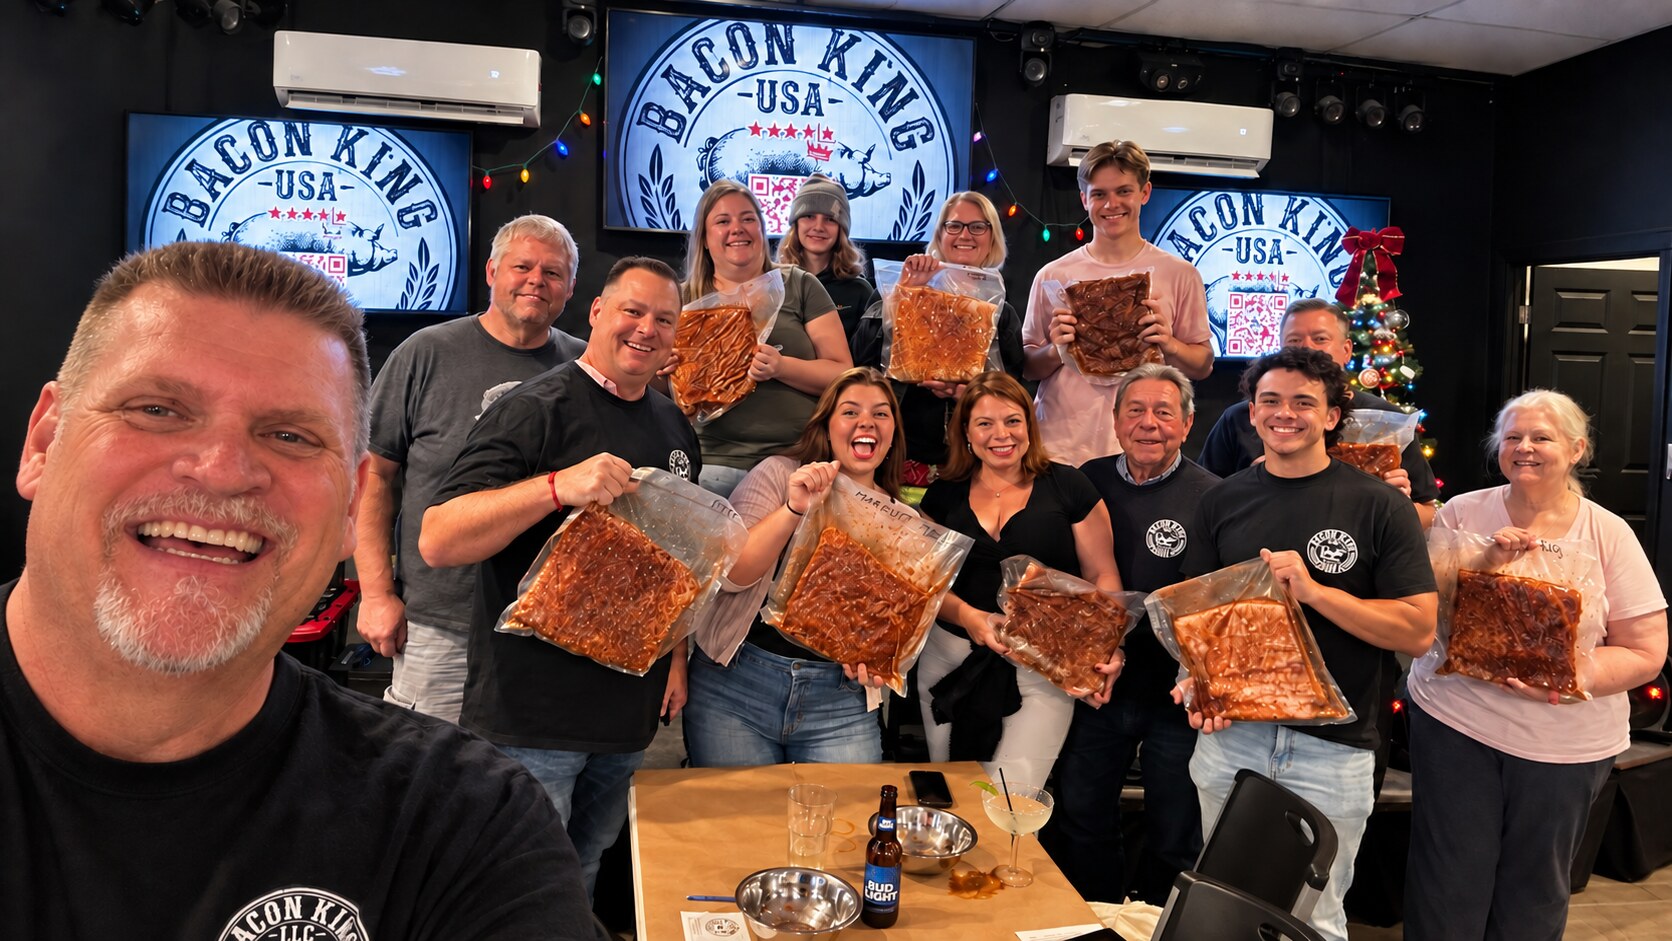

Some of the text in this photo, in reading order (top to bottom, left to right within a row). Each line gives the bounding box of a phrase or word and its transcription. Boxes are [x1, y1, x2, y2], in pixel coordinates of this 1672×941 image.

[636, 23, 935, 151] BACON KING
[756, 79, 824, 117] USA
[161, 119, 439, 230] BACON KING
[275, 169, 338, 202] USA
[1167, 193, 1265, 262] ACON
[1236, 236, 1284, 265] USA
[864, 885, 898, 902] LIGHT
[867, 880, 894, 893] BUD
[231, 896, 302, 941] ACON
